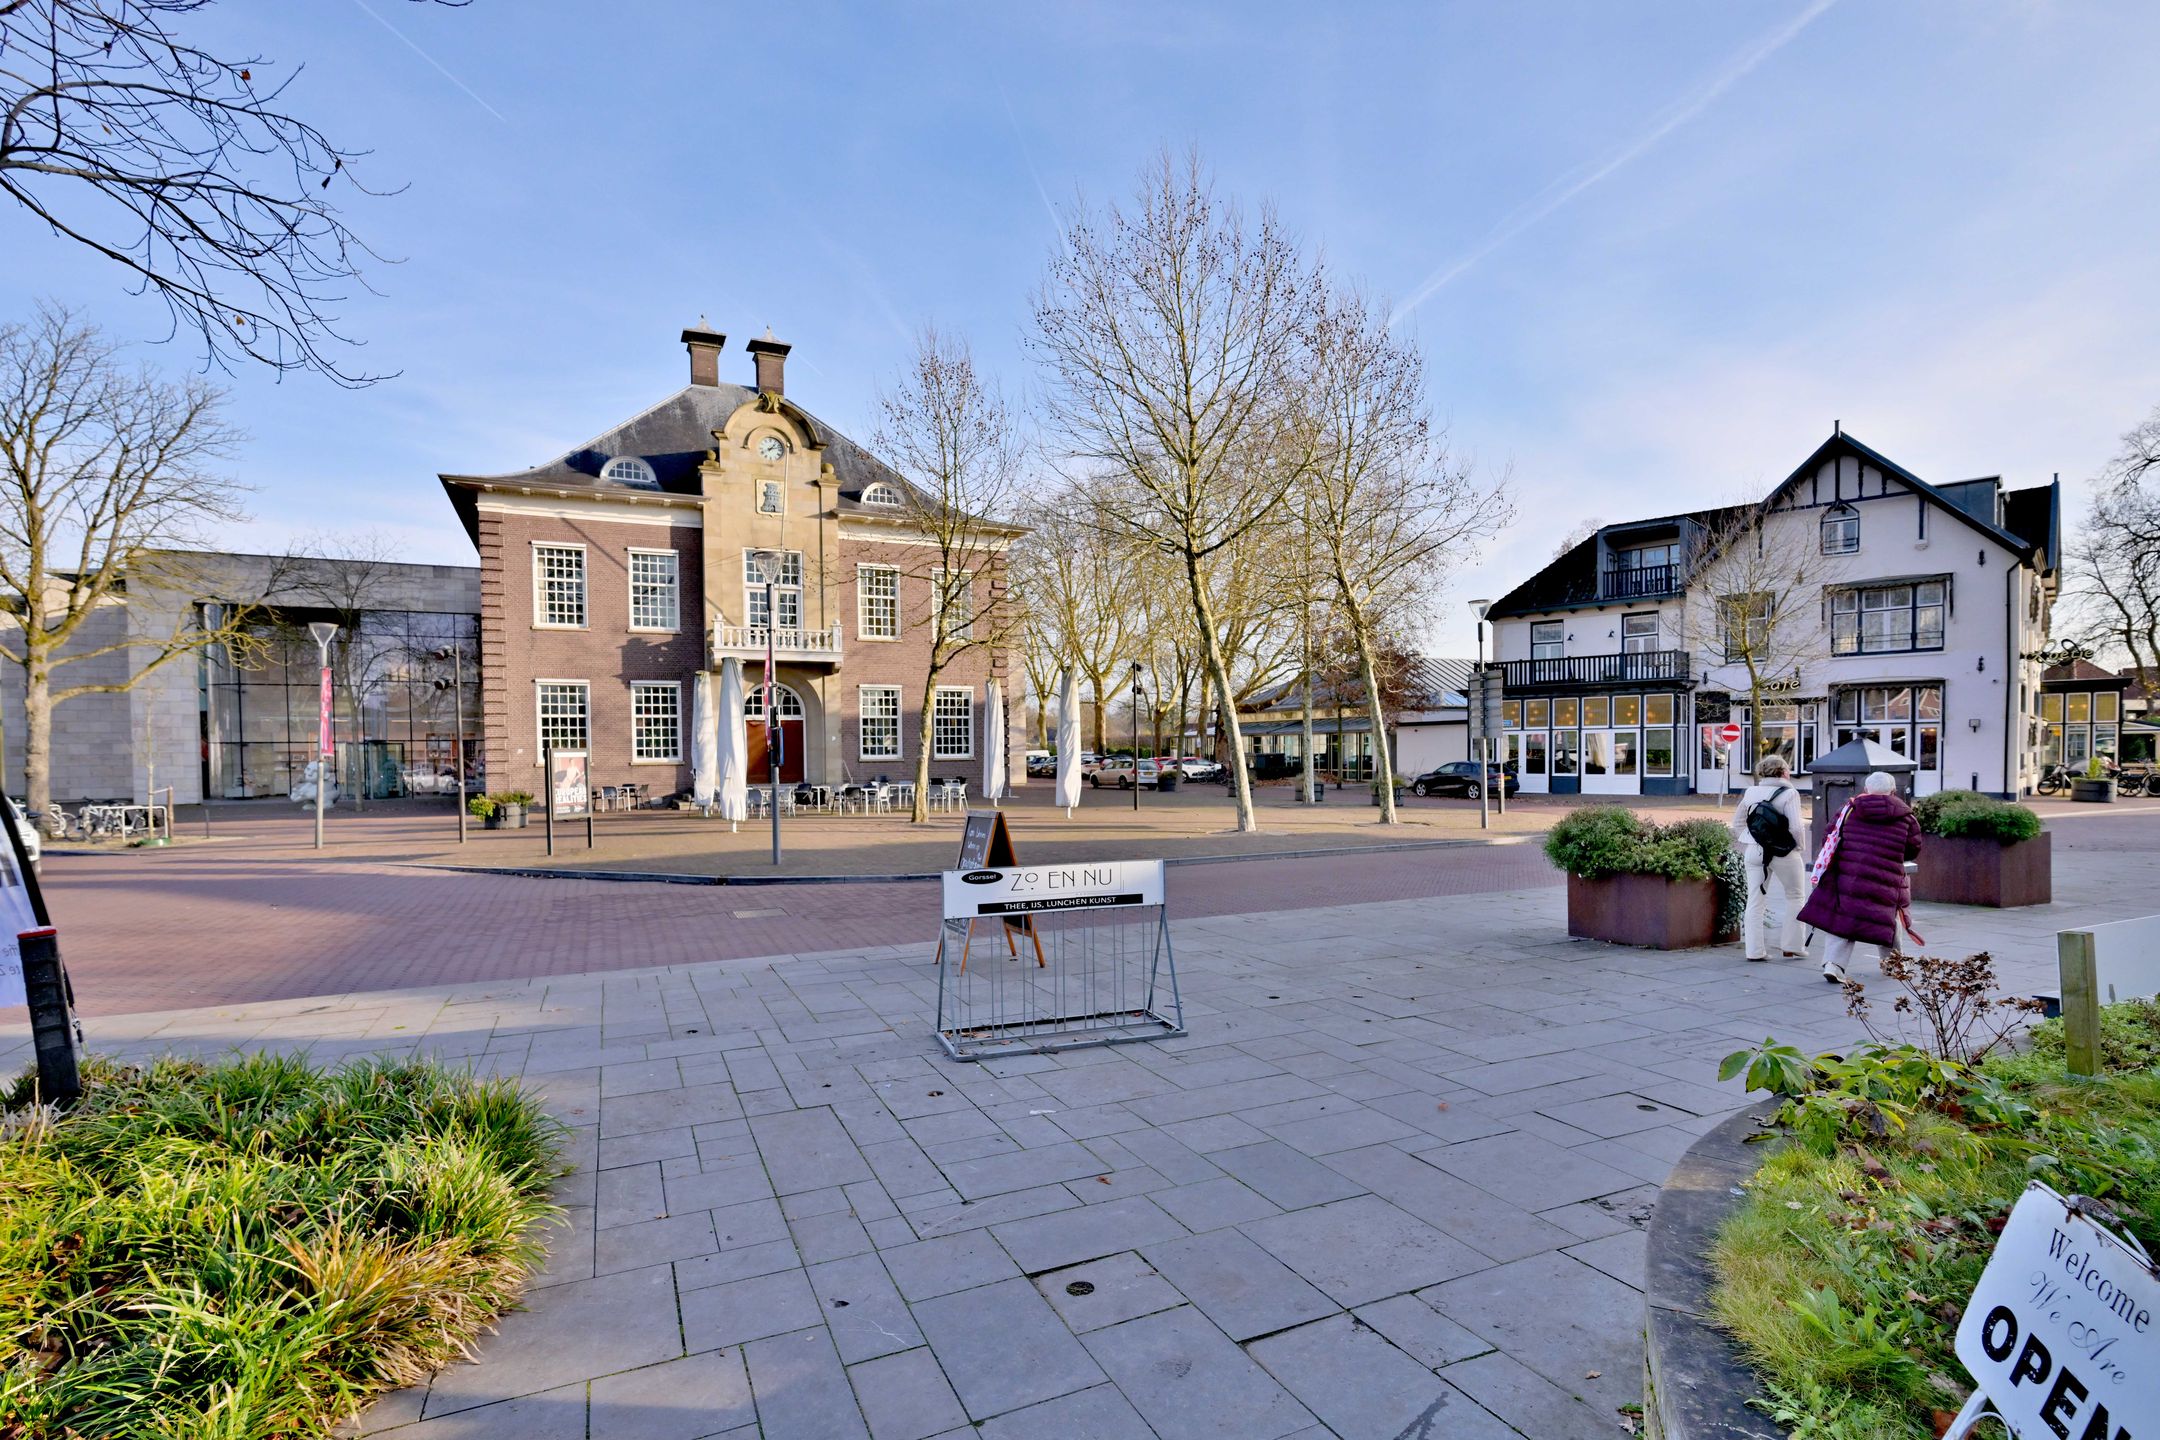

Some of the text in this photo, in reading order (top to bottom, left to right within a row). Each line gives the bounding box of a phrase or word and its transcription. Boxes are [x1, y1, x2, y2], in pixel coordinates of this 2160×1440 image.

[968, 872, 997, 881] Gorssel
[1048, 870, 1075, 889] EN
[1084, 868, 1112, 886] NU
[1004, 902, 1028, 910] THEE,
[1089, 896, 1117, 905] KUNST
[2048, 1227, 2151, 1334] Welcome
[2029, 1270, 2126, 1385] We Are
